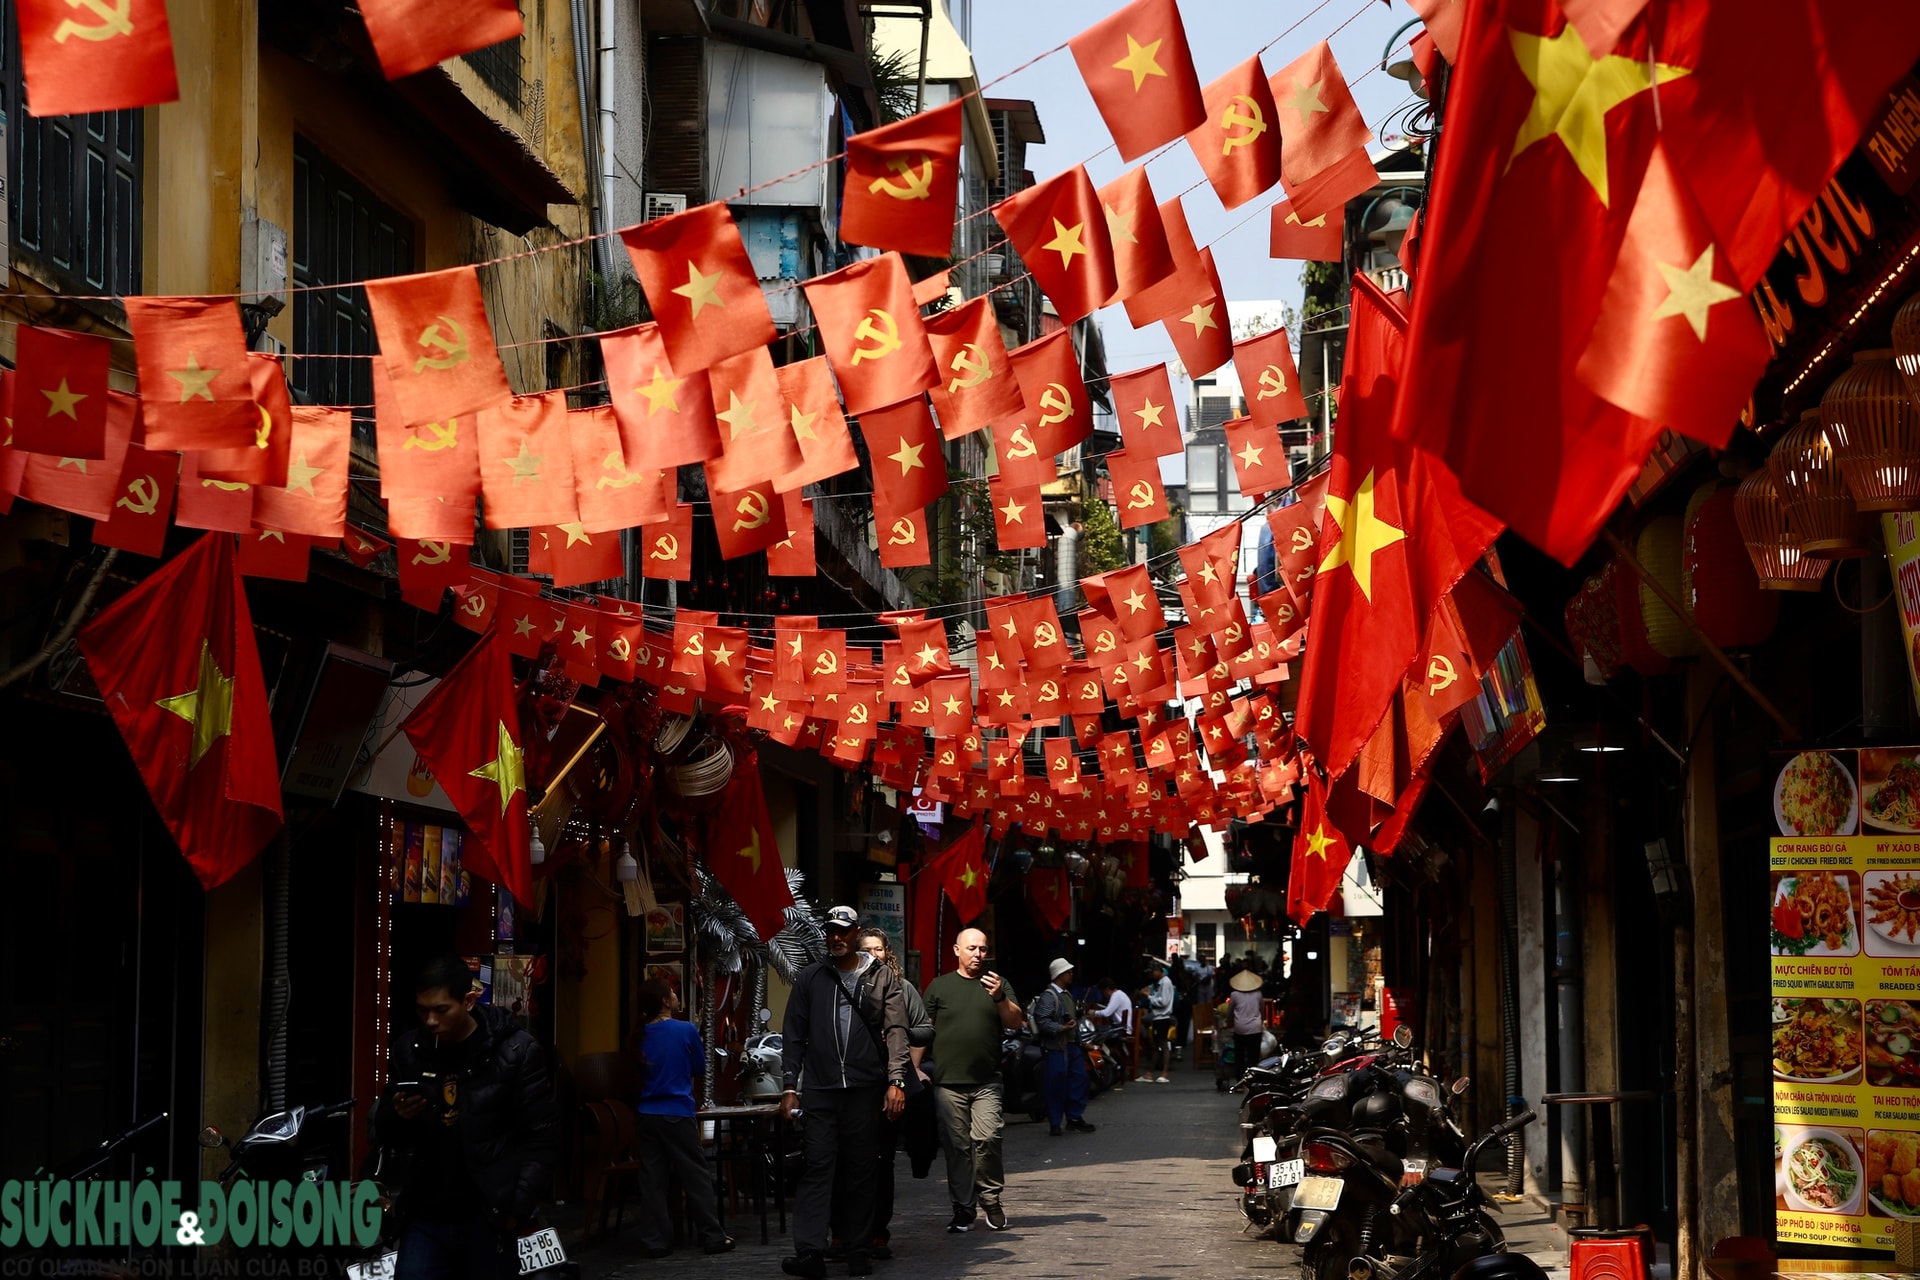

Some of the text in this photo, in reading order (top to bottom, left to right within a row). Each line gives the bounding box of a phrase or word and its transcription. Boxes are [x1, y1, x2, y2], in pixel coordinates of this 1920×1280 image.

[1796, 844, 1818, 853] RANG
[1772, 857, 1787, 866] BEEF
[1791, 857, 1817, 865] CHICKEN
[1820, 856, 1837, 865] FRIED
[1839, 856, 1853, 865] RICE
[862, 902, 901, 912] VEGETABLE
[1775, 966, 1795, 976] MỰC
[1797, 964, 1821, 975] CHIÊN
[1881, 965, 1902, 976] TÔM
[1773, 979, 1854, 989] FRIED SQUID WITH GARLIC BUTTER
[1790, 1091, 1804, 1101] CHÂN
[1815, 1092, 1829, 1104] TRỘN
[1873, 1096, 1883, 1105] TAI
[1886, 1096, 1900, 1106] HEO
[1774, 1106, 1858, 1118] CHICKEN LEG SALAD MIXED WITH MANGO
[1883, 1111, 1891, 1119] EAR
[1893, 1112, 1907, 1120] SALAD
[1275, 1161, 1299, 1175] 35-K1
[1272, 1172, 1302, 1187] 697.81
[1790, 1217, 1804, 1228] PHỞ
[1835, 1220, 1849, 1232] PHỞ
[518, 1233, 553, 1255] 29-BG
[1809, 1233, 1827, 1241] SOUP
[1832, 1235, 1861, 1244] CHICKEN
